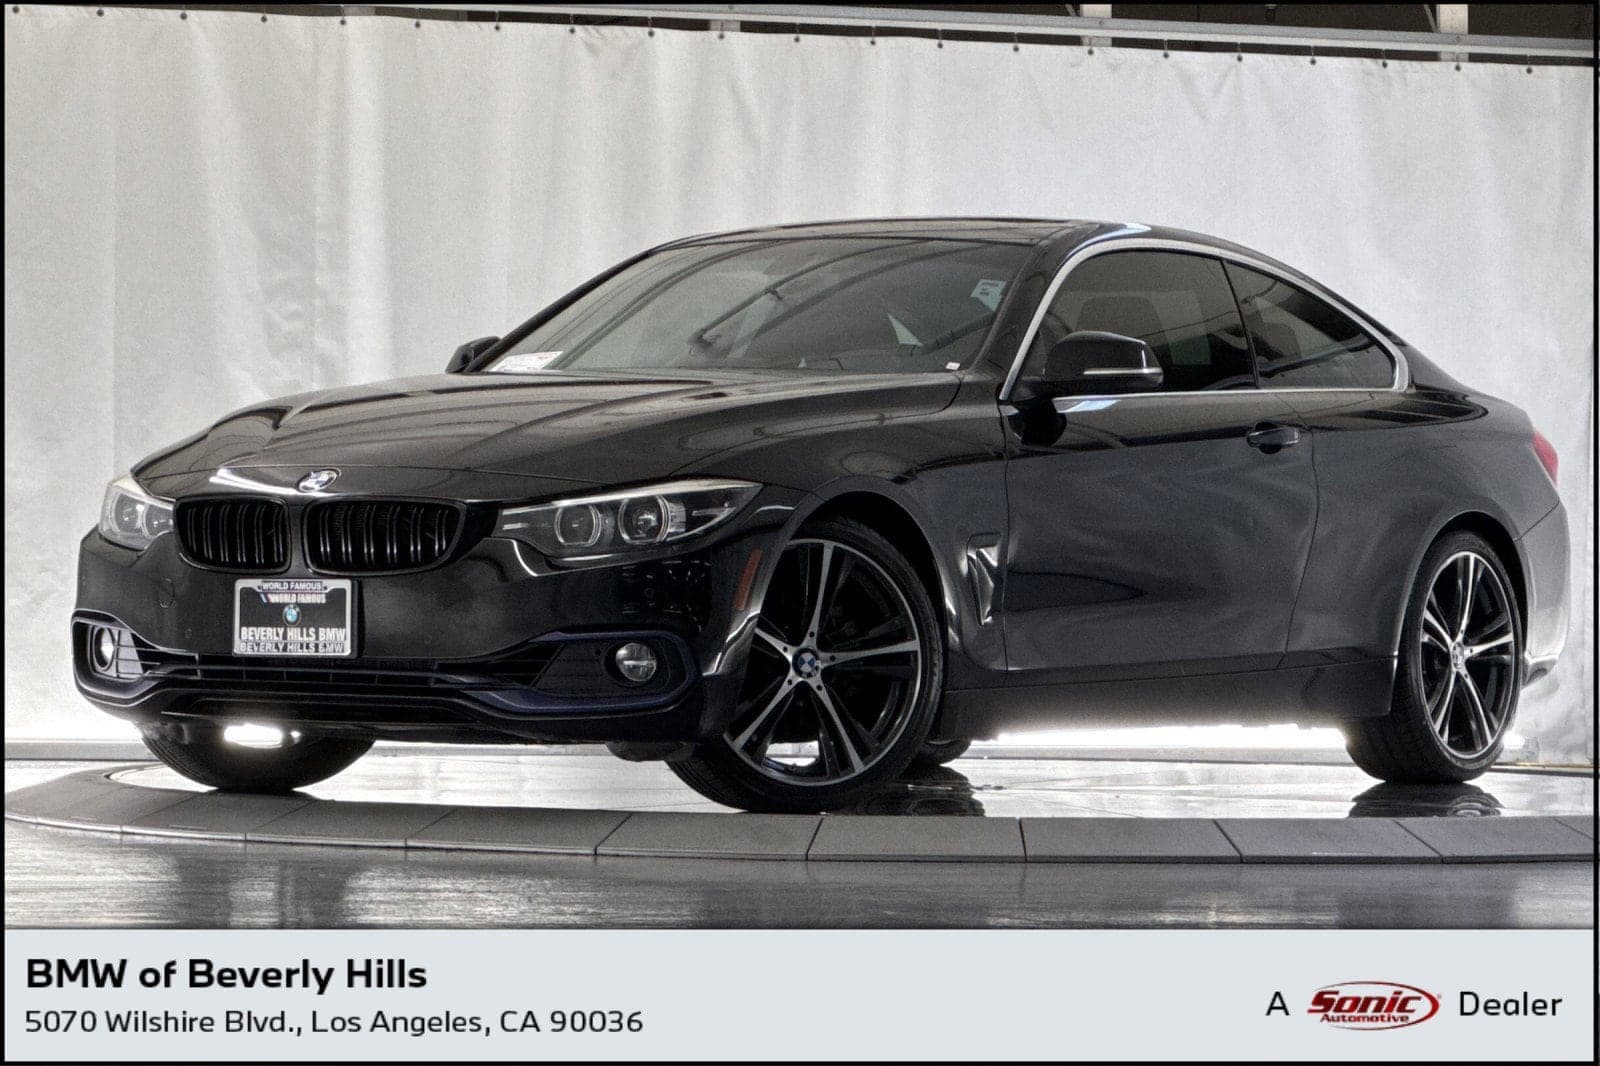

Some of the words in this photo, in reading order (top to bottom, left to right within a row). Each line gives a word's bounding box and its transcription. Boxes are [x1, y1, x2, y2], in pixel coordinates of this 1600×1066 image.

[262, 582, 288, 590] WORLD
[290, 581, 322, 590] FAMOUS
[241, 627, 285, 641] BEVERLY
[286, 627, 316, 641] HILLS
[318, 627, 346, 642] BMW
[240, 641, 285, 653] BEVERLY
[286, 641, 316, 653] HILLS
[318, 642, 344, 654] BMW
